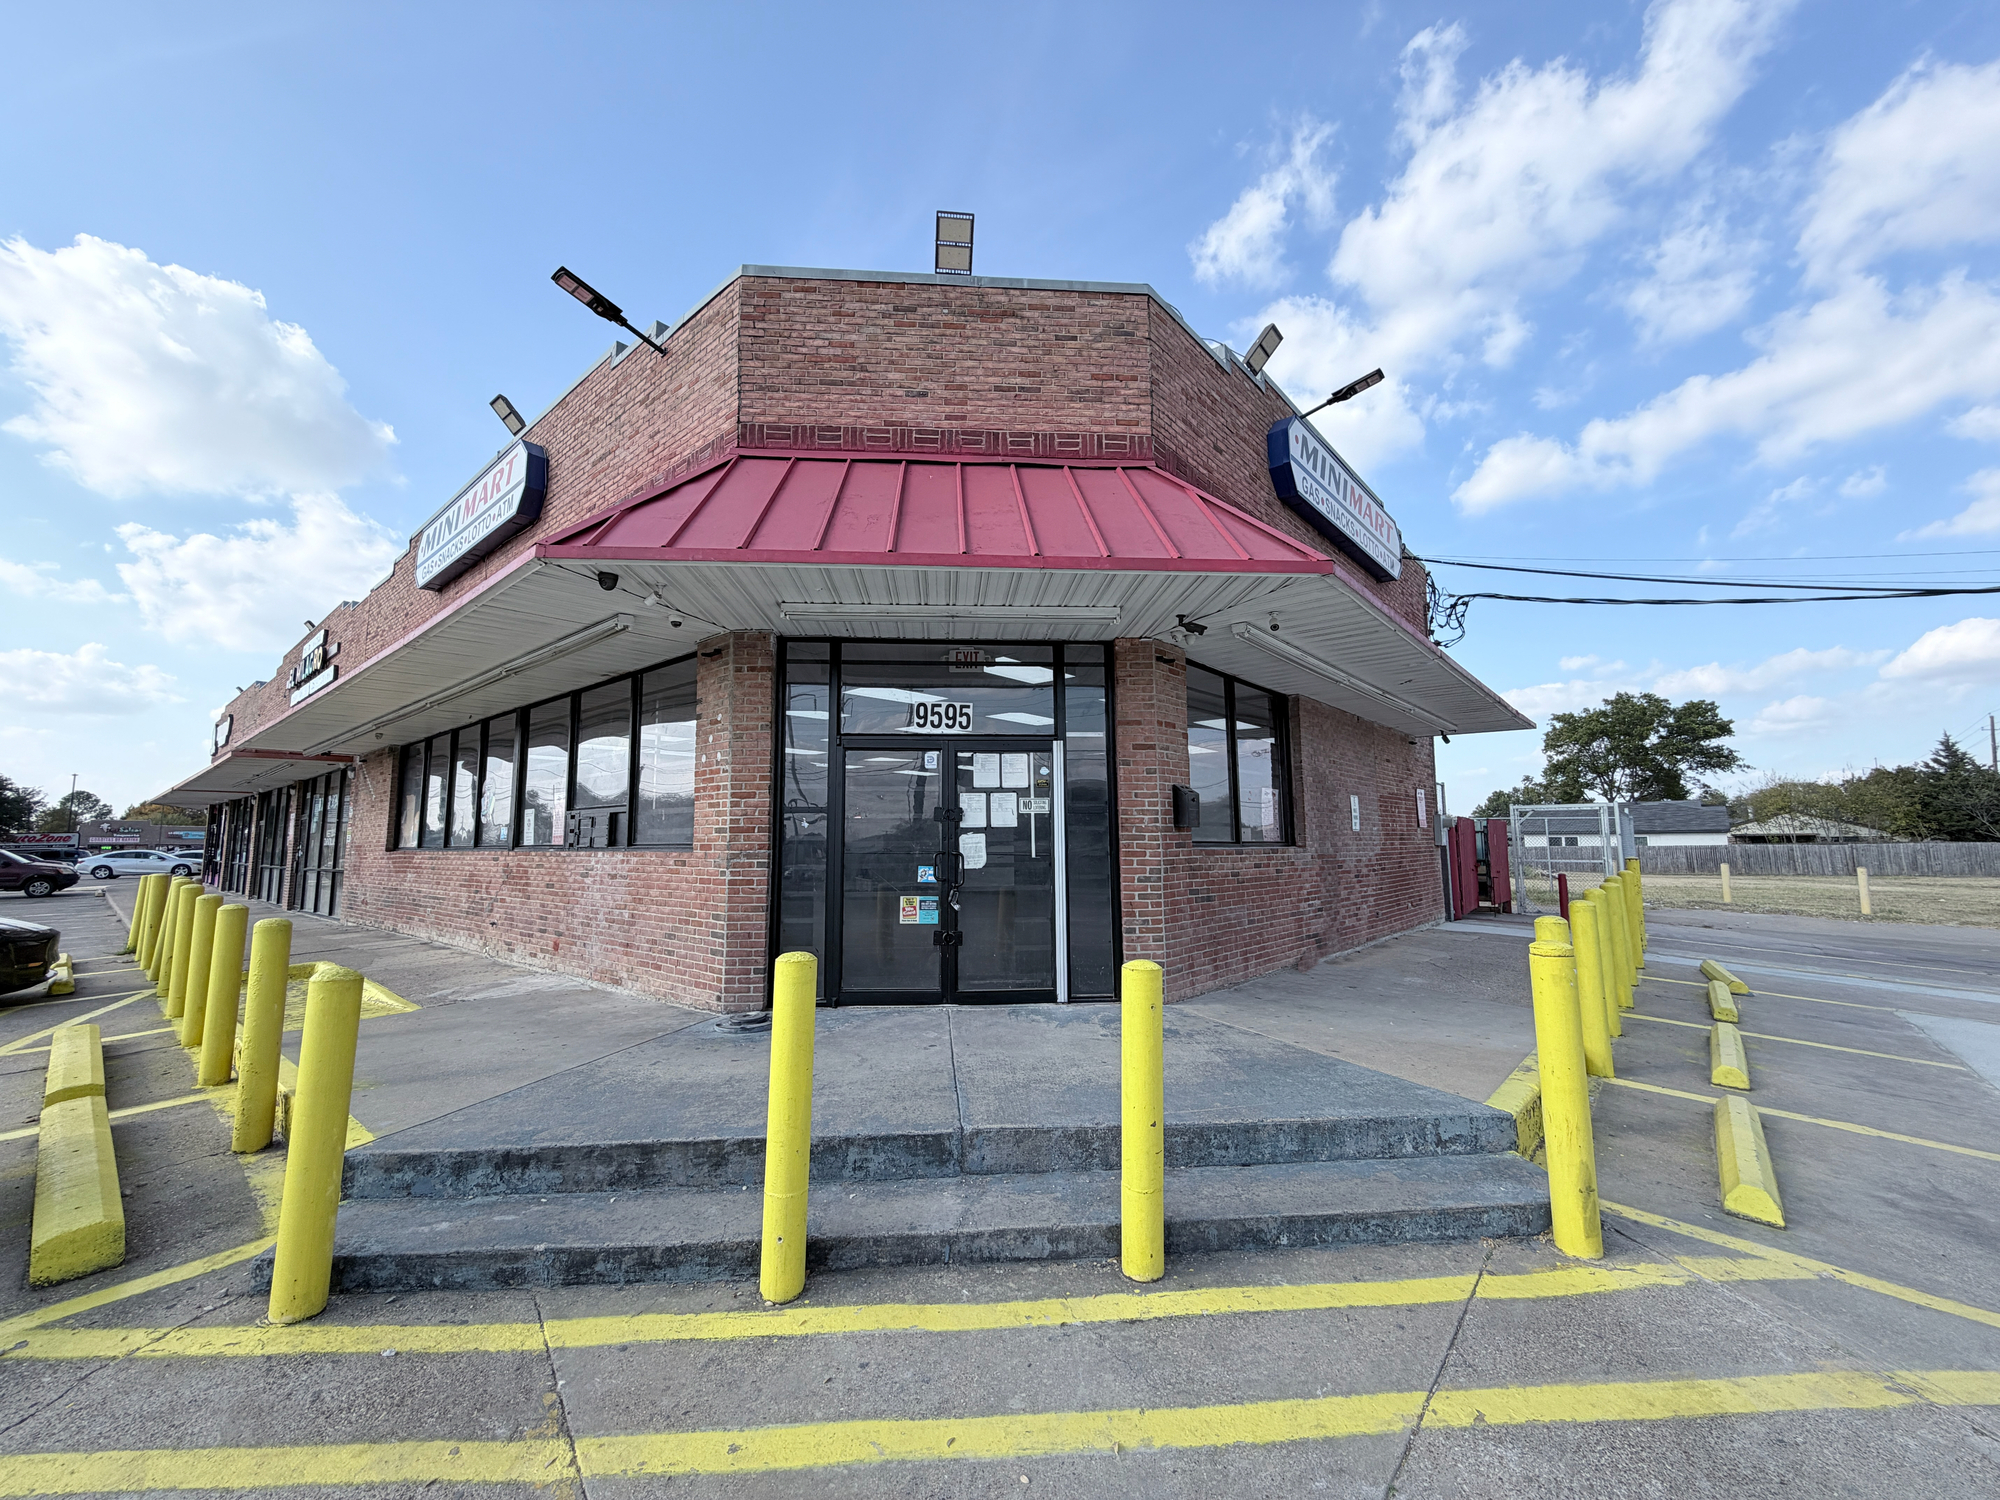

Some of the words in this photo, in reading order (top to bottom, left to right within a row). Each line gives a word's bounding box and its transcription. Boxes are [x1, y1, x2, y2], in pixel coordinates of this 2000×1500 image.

[1301, 476, 1321, 506] GAS
[1325, 498, 1357, 538] SNACKS
[1358, 528, 1380, 559] LOTTO
[421, 559, 435, 580] GAS
[437, 536, 465, 568] SNACKS
[467, 513, 492, 543] LOTTO
[495, 494, 514, 523] ATM
[955, 651, 980, 669] EXIT
[915, 702, 972, 730] 9595
[1022, 800, 1032, 810] NO
